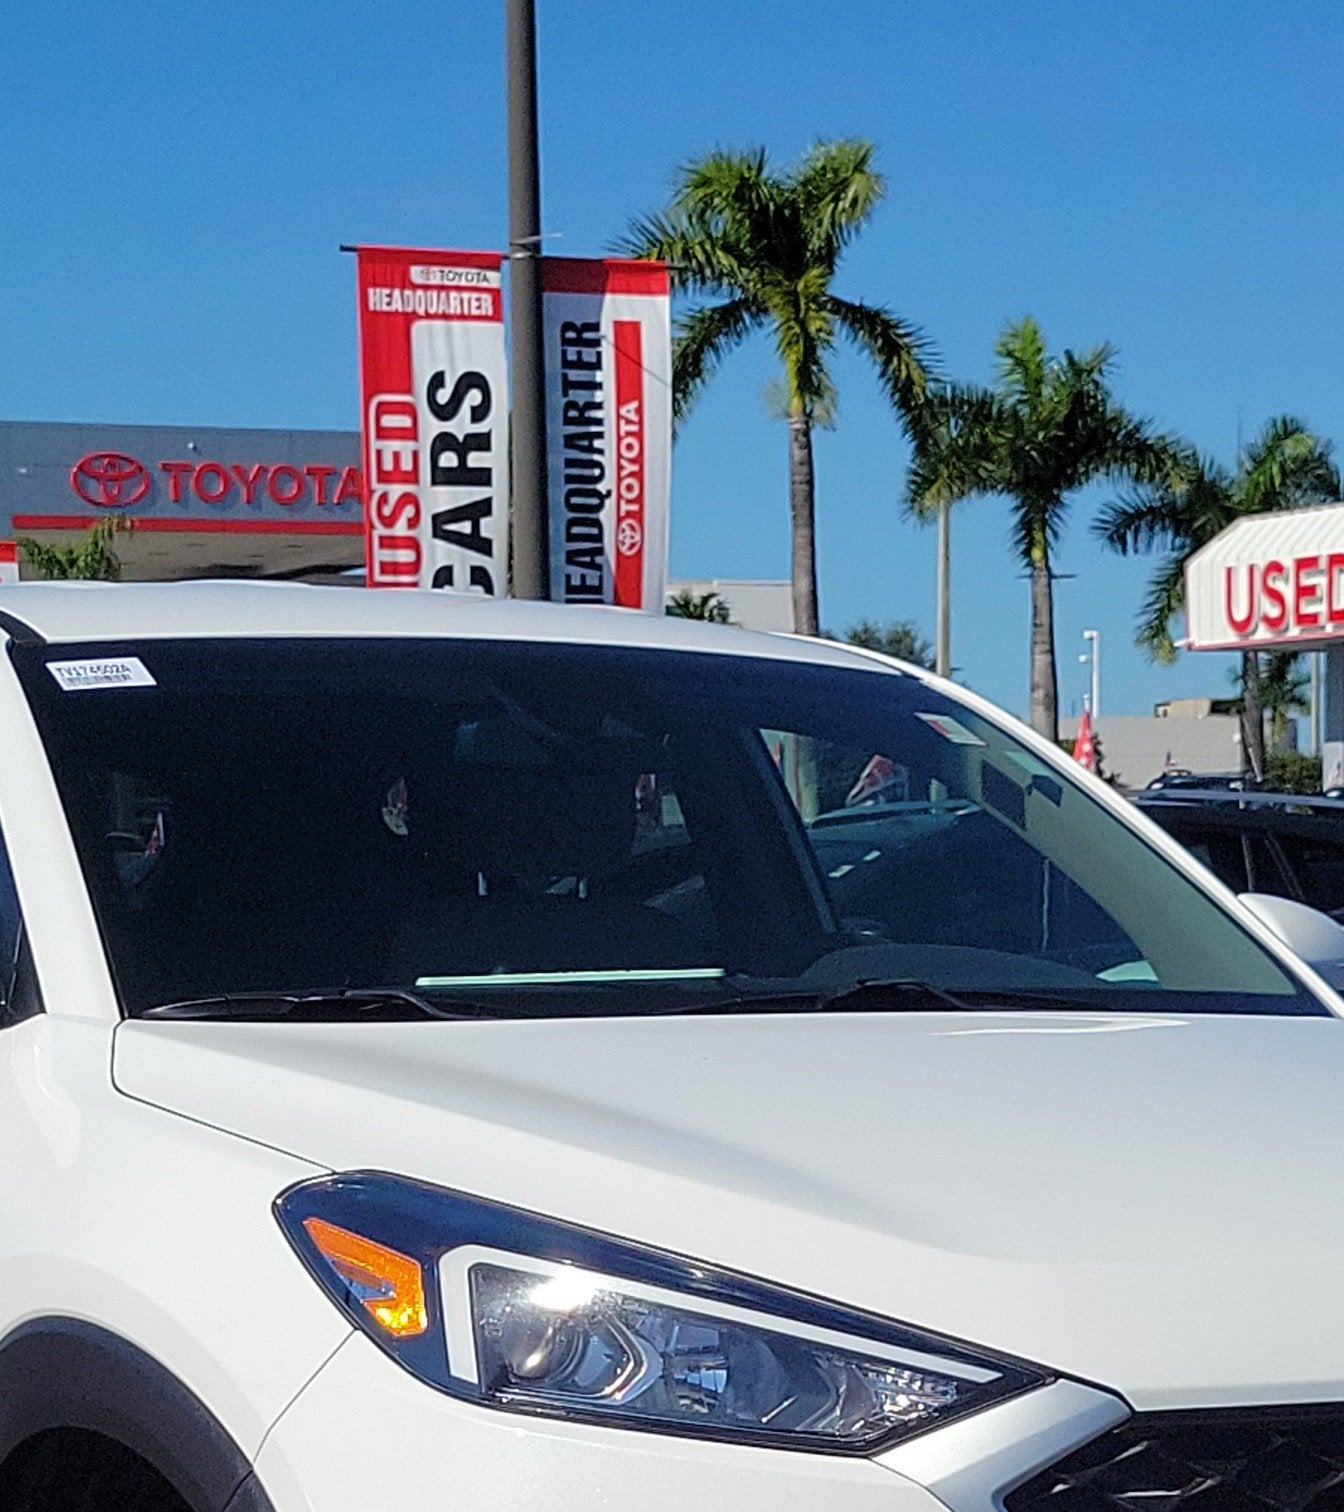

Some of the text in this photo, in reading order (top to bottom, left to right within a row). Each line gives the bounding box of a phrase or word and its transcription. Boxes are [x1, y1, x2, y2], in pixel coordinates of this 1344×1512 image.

[367, 287, 494, 318] HEADQUARTER
[438, 269, 491, 285] TOYOTA
[159, 461, 363, 506] TOYOTA
[371, 396, 422, 580] USED
[560, 320, 613, 603] EADQUARTER
[619, 400, 640, 516] TOYOTA
